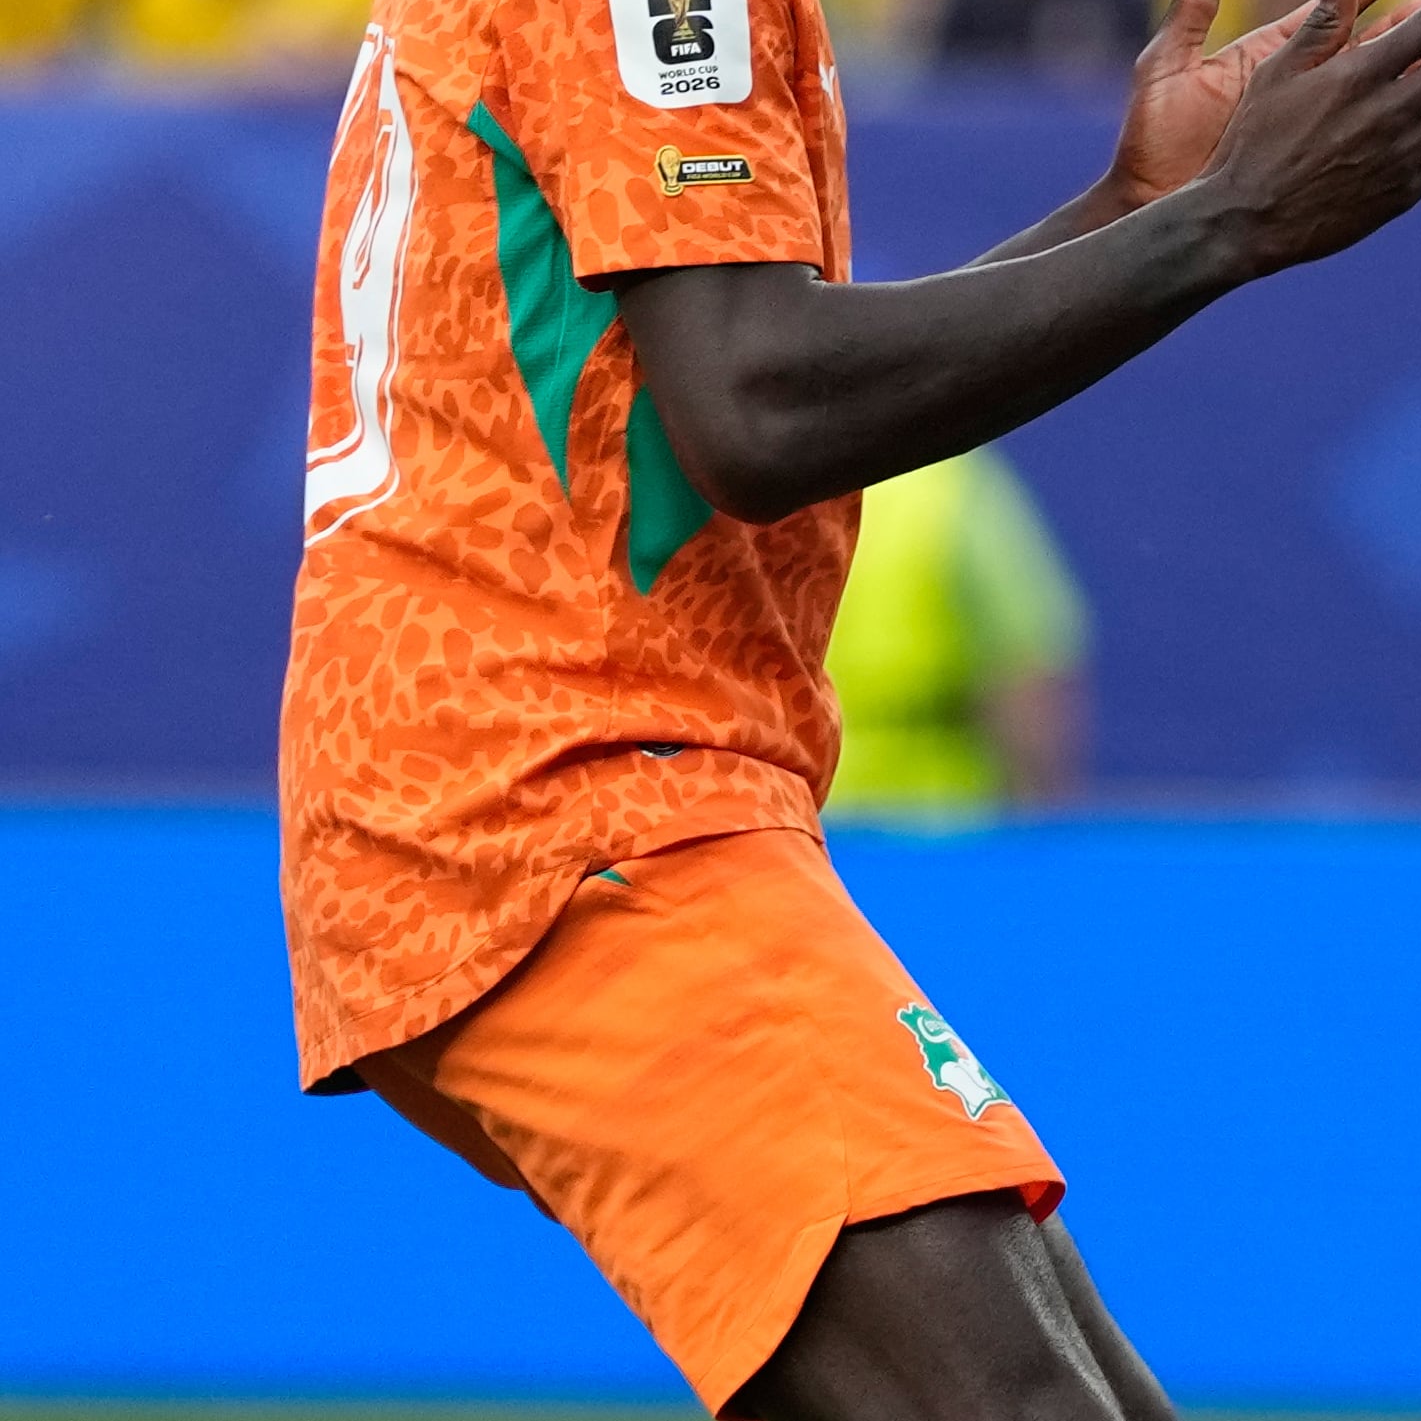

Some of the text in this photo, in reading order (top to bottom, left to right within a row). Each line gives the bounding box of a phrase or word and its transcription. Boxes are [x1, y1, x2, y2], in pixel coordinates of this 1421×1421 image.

[670, 42, 702, 57] FIFA
[658, 65, 719, 80] WORLD CUP
[660, 76, 721, 96] 2026
[681, 161, 744, 174] DEBUT
